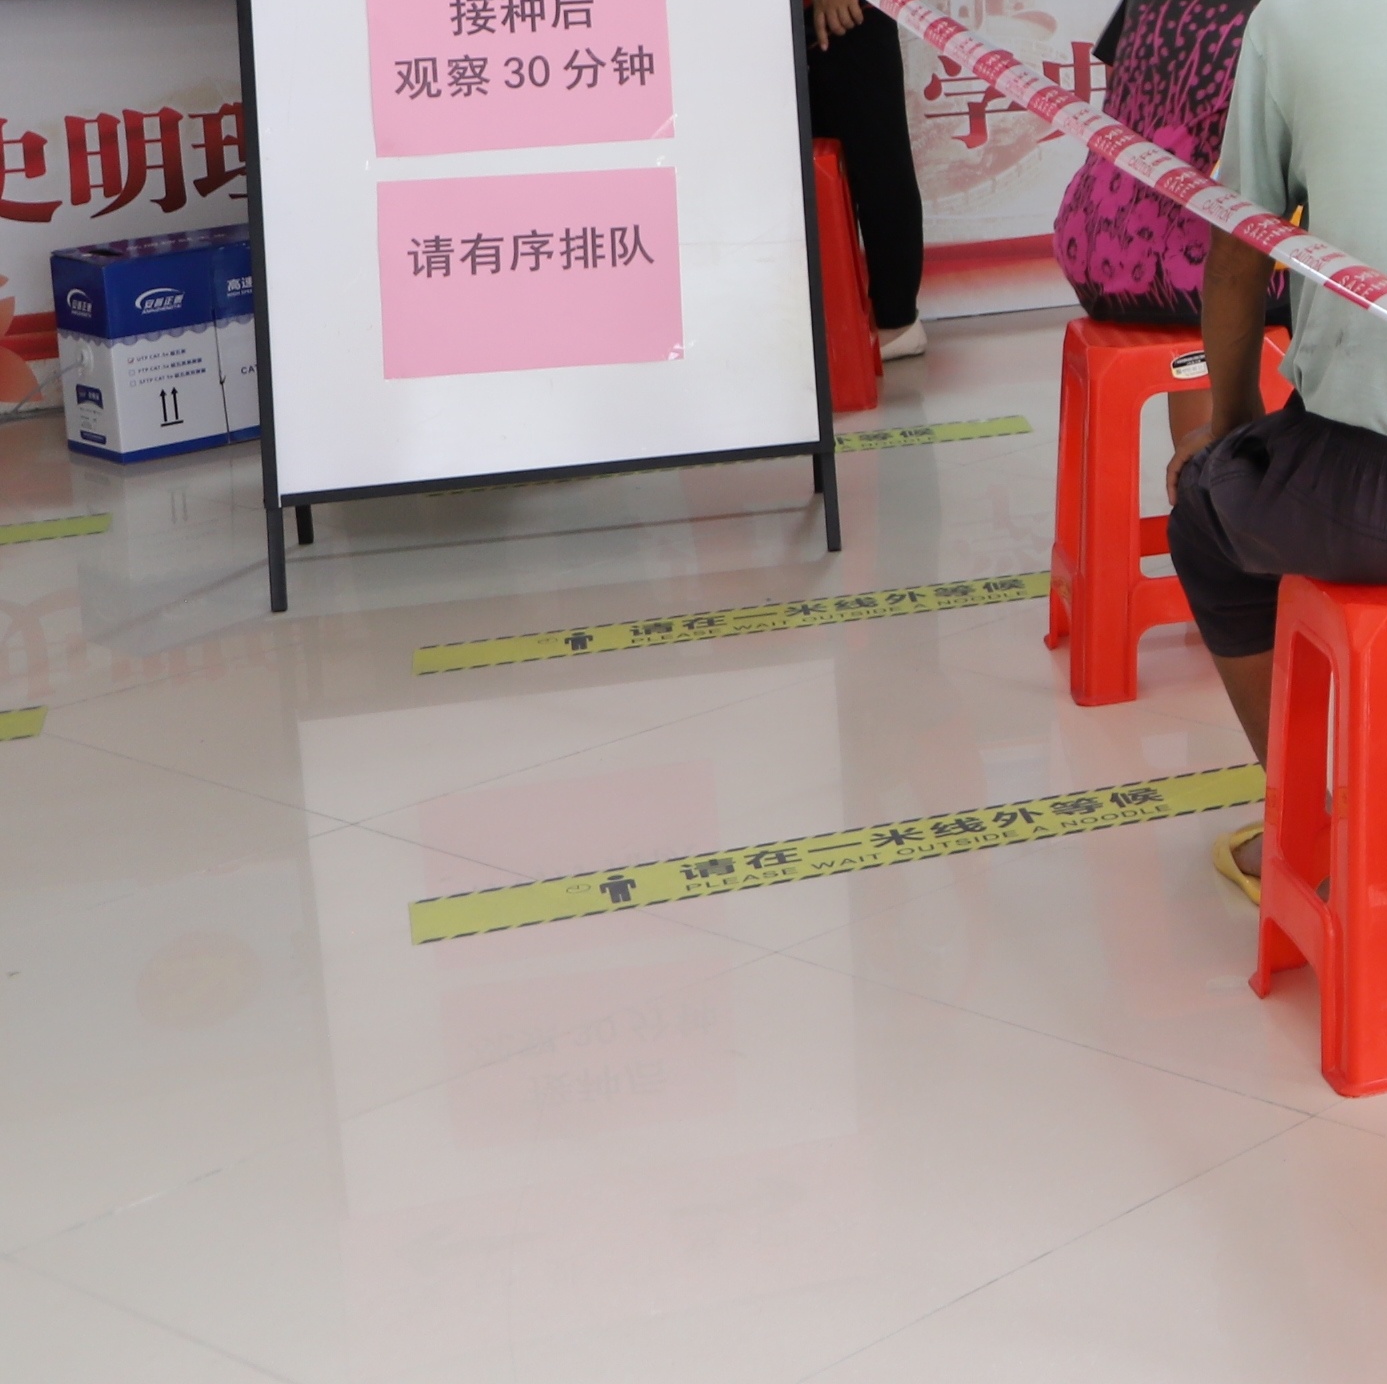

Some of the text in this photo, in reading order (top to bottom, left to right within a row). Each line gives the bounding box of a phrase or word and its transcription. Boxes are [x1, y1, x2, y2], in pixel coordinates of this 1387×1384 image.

[394, 44, 655, 100] 观察30分钟
[407, 224, 655, 279] 请有序排队
[1339, 275, 1374, 300] SAFE
[240, 364, 258, 375] CA
[629, 578, 1026, 637] 请在一米线外等候
[630, 627, 721, 644] PLEASE
[732, 617, 788, 632] WAIT
[800, 604, 902, 624] OUTSIDE
[937, 589, 1029, 607] NOODLE
[680, 786, 1166, 881] 请在一米线外等候
[685, 803, 1173, 893] PLEASE WAIT OUTSIDE A NOODLE
